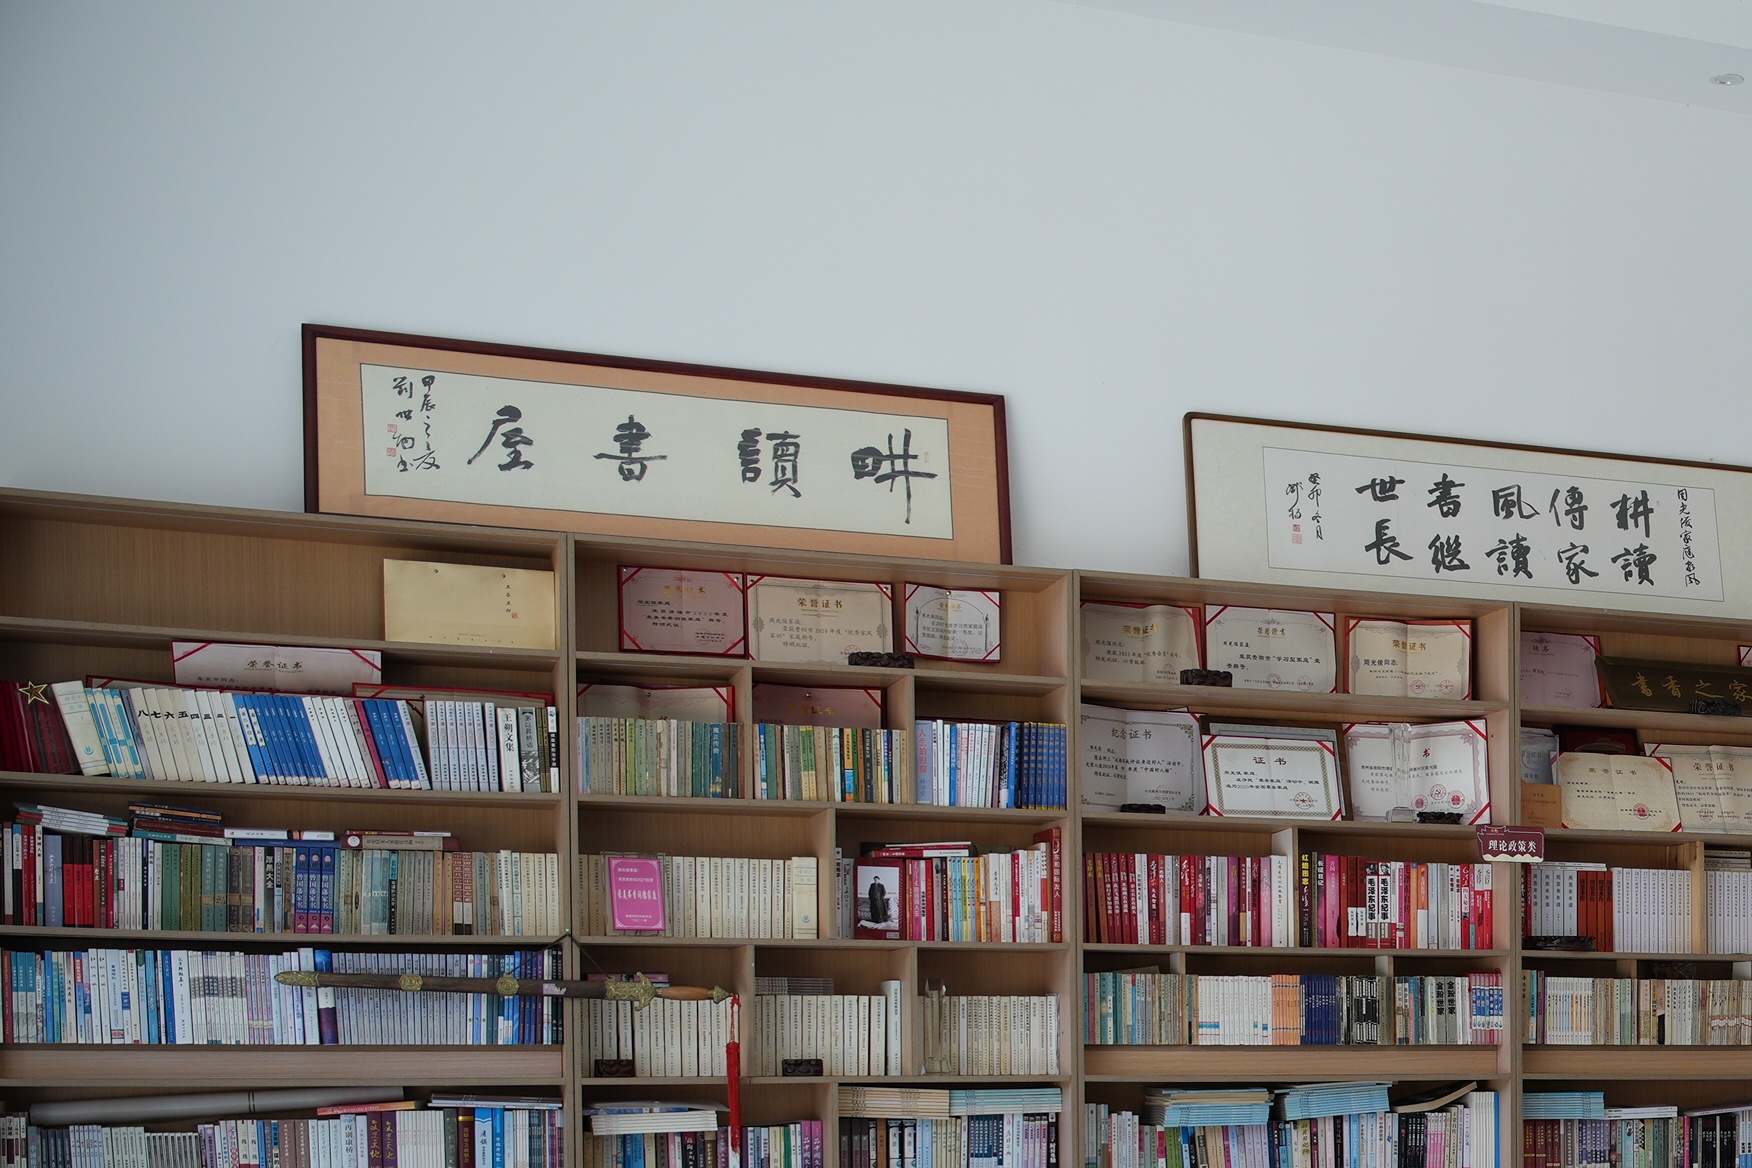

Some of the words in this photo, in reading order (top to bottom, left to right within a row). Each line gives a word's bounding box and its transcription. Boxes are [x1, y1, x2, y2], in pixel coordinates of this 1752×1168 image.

[503, 713, 515, 752] 王朔文集
[918, 729, 928, 773] 人生的归宿
[1488, 840, 1536, 852] 理论政策类
[1367, 877, 1376, 921] 毛泽东纪事
[1380, 877, 1389, 921] 毛泽东纪事
